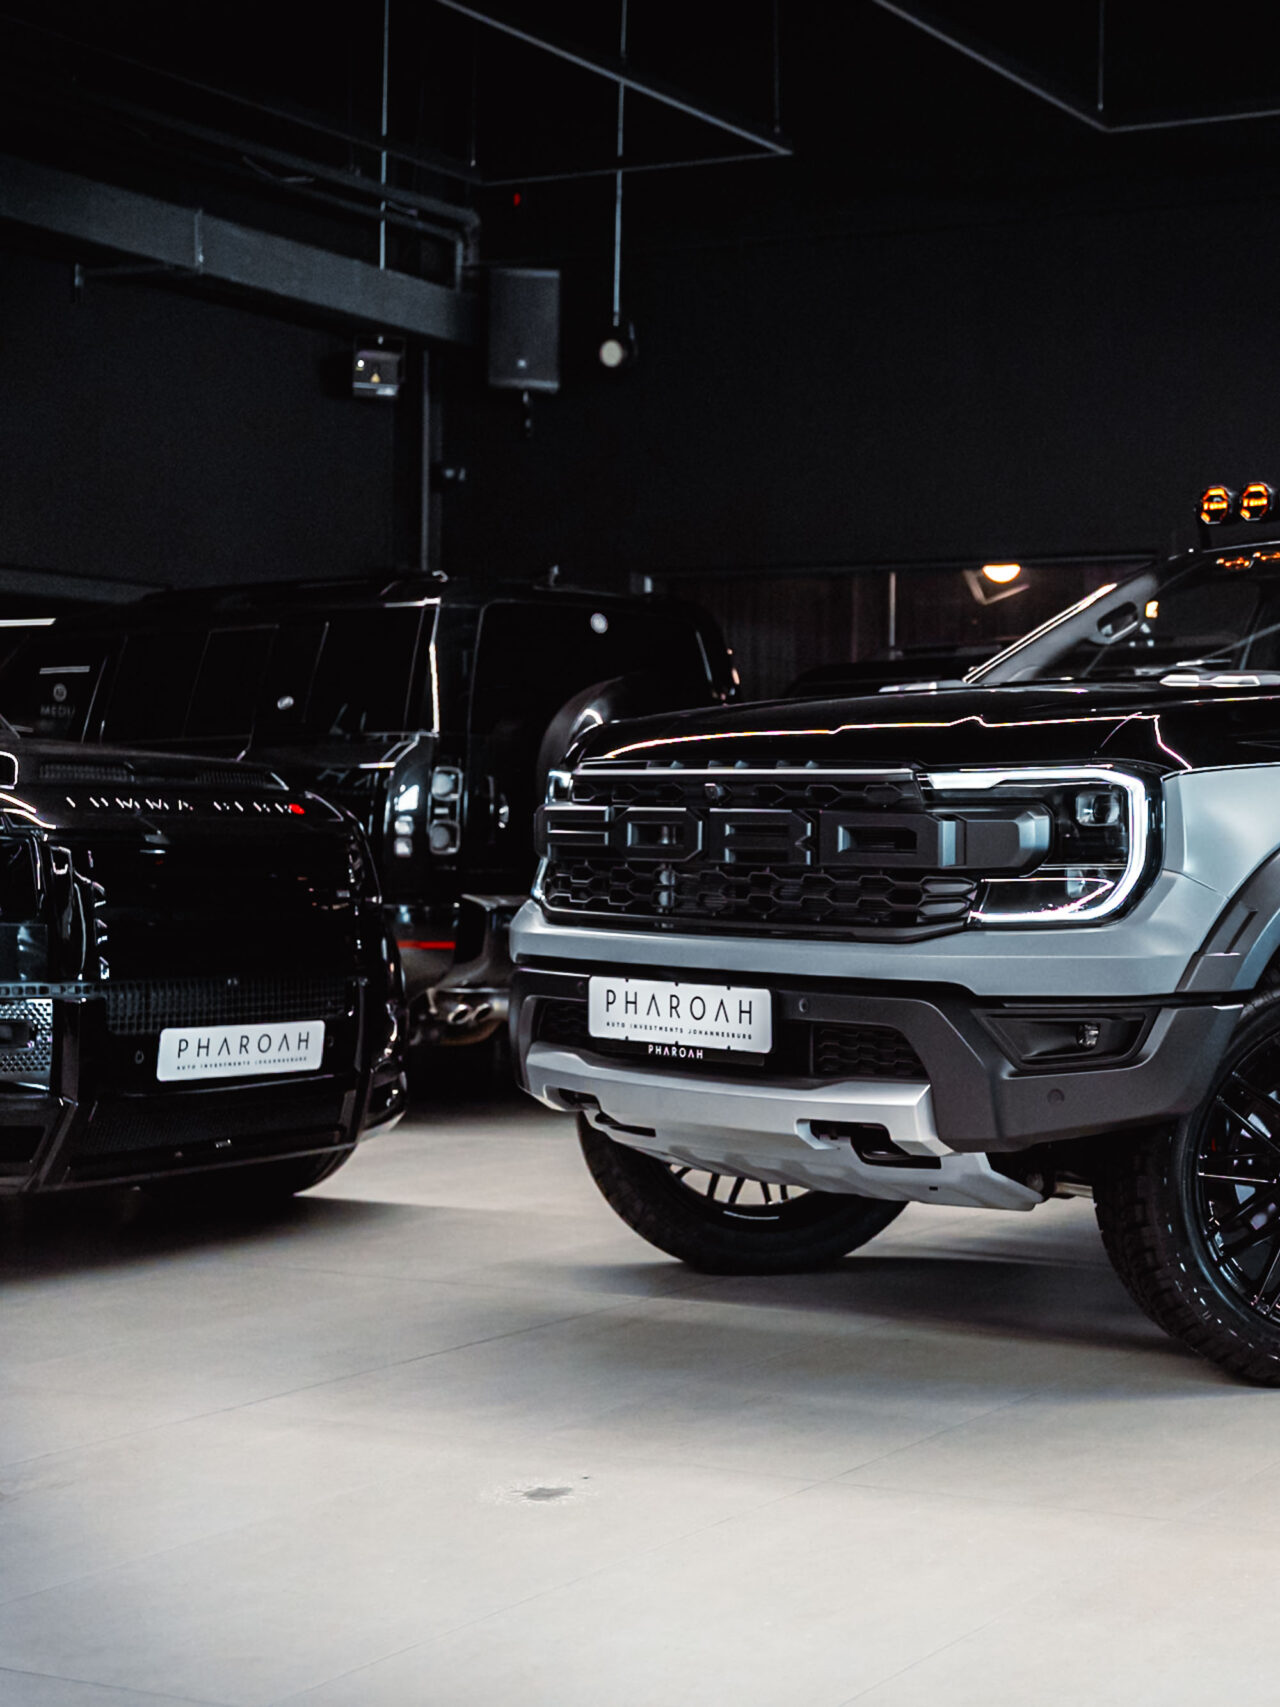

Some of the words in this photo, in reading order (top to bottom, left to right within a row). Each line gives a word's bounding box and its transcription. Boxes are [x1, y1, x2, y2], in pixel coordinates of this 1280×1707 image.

[534, 804, 958, 868] FORD
[605, 988, 753, 1026] PHAROAH
[177, 1031, 310, 1059] PHAROAH
[606, 1021, 626, 1029] AUTO
[630, 1023, 684, 1034] INVESTMENTS
[688, 1029, 752, 1041] JOHANNESBURG
[648, 1043, 704, 1060] PHAROAH
